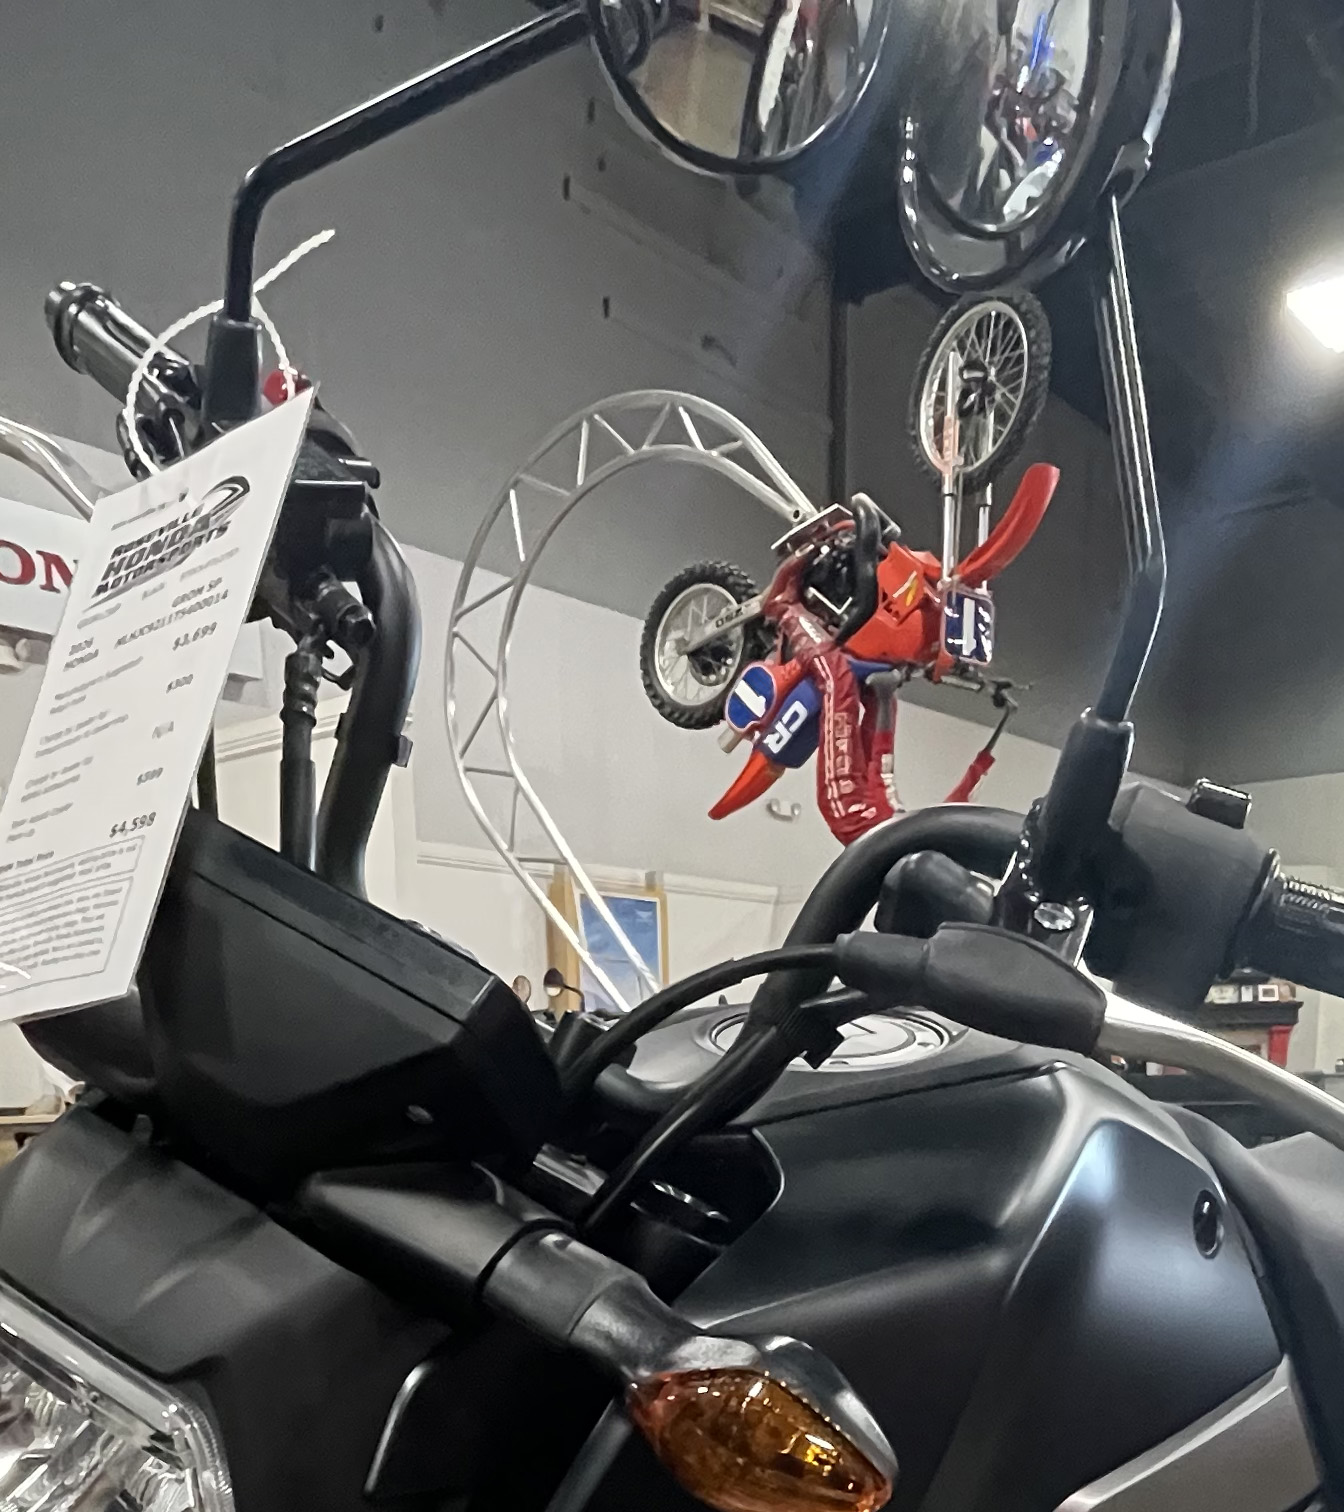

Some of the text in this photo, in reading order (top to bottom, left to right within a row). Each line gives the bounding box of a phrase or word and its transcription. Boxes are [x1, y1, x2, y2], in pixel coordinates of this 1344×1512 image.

[91, 519, 232, 599] MOTORSPORTS
[101, 513, 213, 581] HONDA
[734, 679, 767, 718] 1
[762, 700, 808, 754] CR
[109, 811, 157, 838] $4,598
